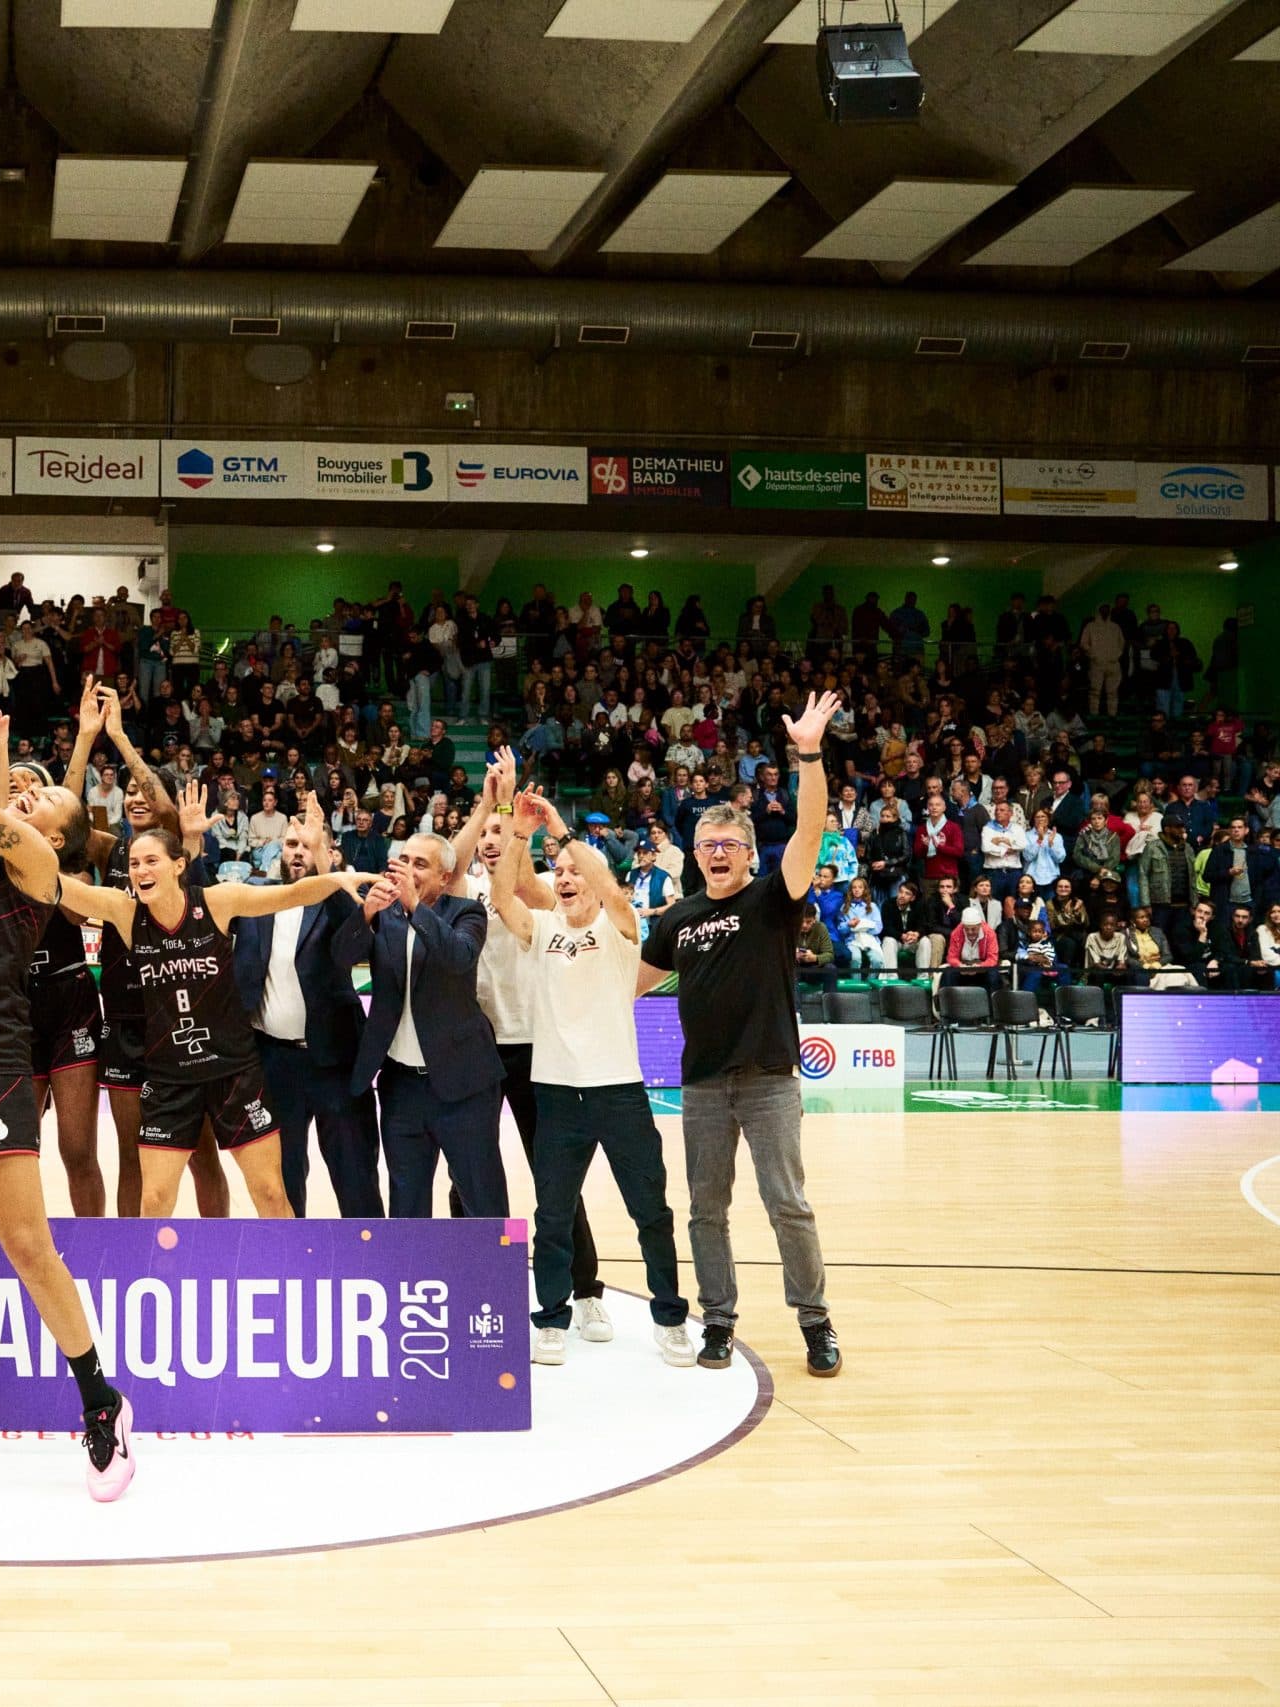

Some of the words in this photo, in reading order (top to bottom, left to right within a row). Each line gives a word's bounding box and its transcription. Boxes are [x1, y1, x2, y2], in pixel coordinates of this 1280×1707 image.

[223, 457, 278, 472] GTM
[317, 456, 383, 472] Bouygues
[632, 457, 724, 473] DEMATHIEU
[869, 457, 997, 473] IMPRIMERIE
[317, 471, 387, 484] Immobilier
[493, 467, 580, 481] EUROVIA
[633, 472, 676, 485] BARD
[140, 957, 219, 986] FLAMMES
[176, 989, 191, 1012] 8
[852, 1049, 896, 1067] FFBB
[399, 1280, 449, 1380] 2025
